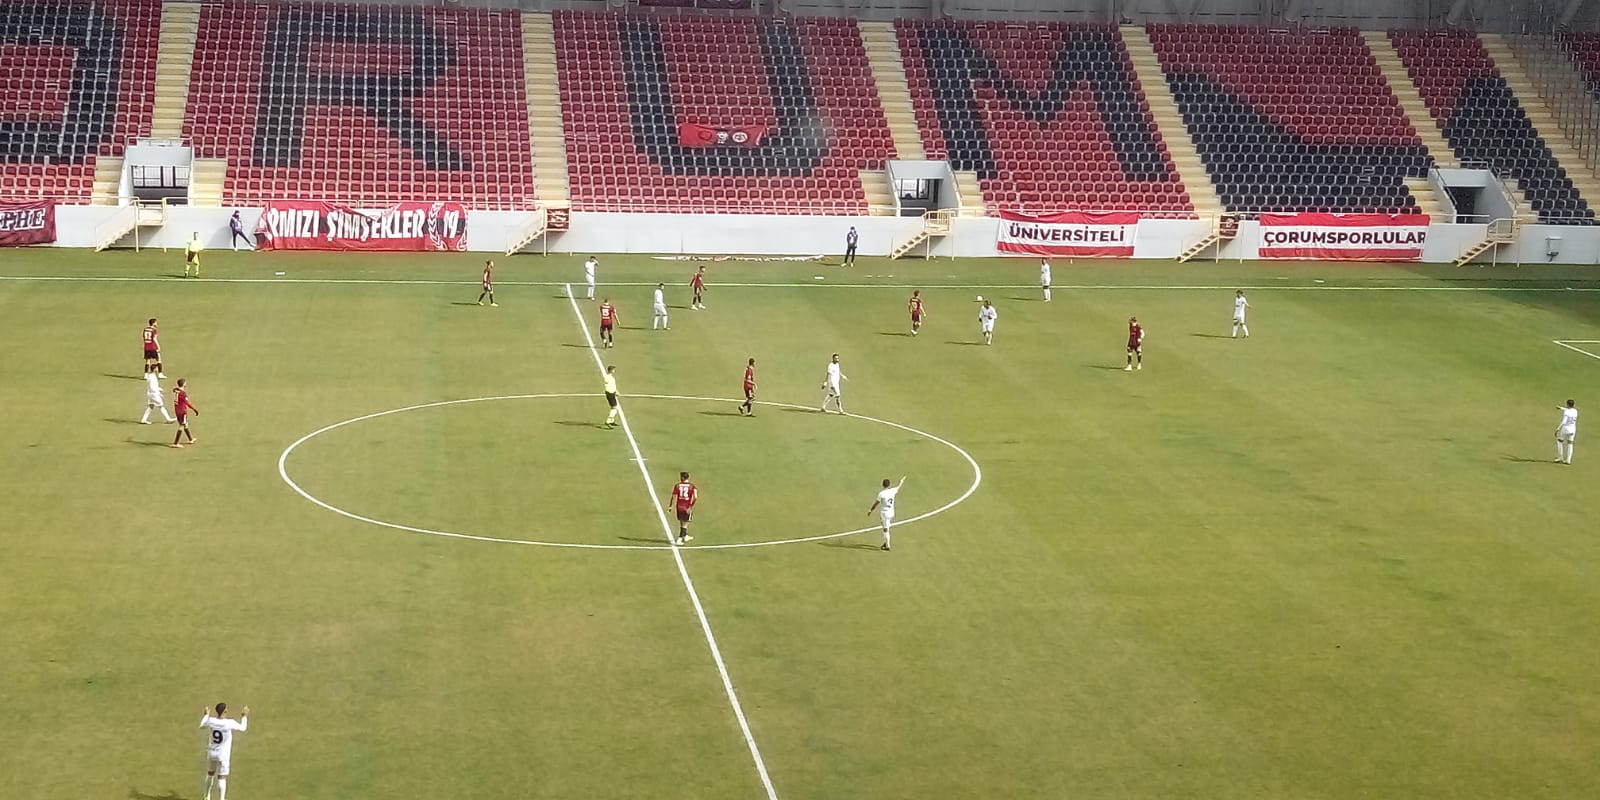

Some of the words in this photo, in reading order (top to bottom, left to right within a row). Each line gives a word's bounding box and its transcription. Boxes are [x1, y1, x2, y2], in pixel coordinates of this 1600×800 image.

[443, 210, 460, 239] 19
[1009, 223, 1125, 242] ÜNİVERSİTELİ
[1264, 231, 1426, 247] ÇORUMSPORLULAR
[679, 486, 690, 498] 12
[212, 730, 223, 744] 9
